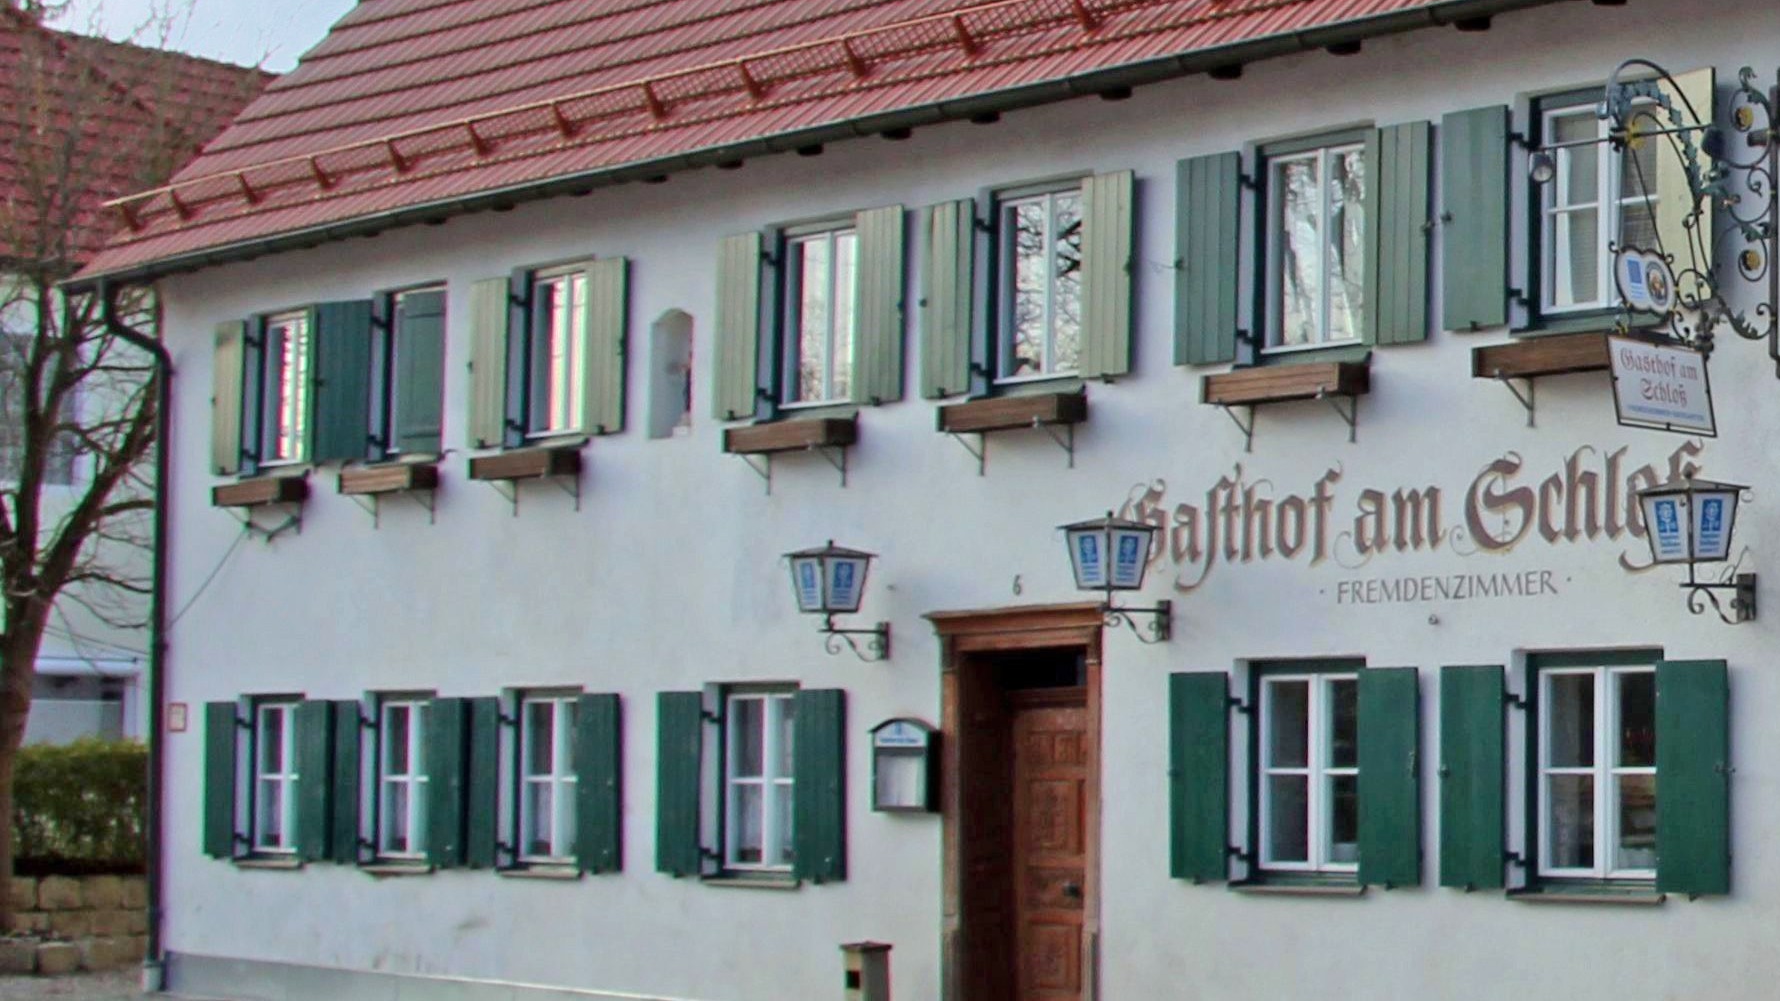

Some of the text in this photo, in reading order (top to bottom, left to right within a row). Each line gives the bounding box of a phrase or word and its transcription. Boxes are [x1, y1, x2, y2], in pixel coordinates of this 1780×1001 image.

[1680, 364, 1698, 380] am
[1352, 484, 1448, 558] am
[1336, 570, 1558, 605] FREMDENZIMMER
